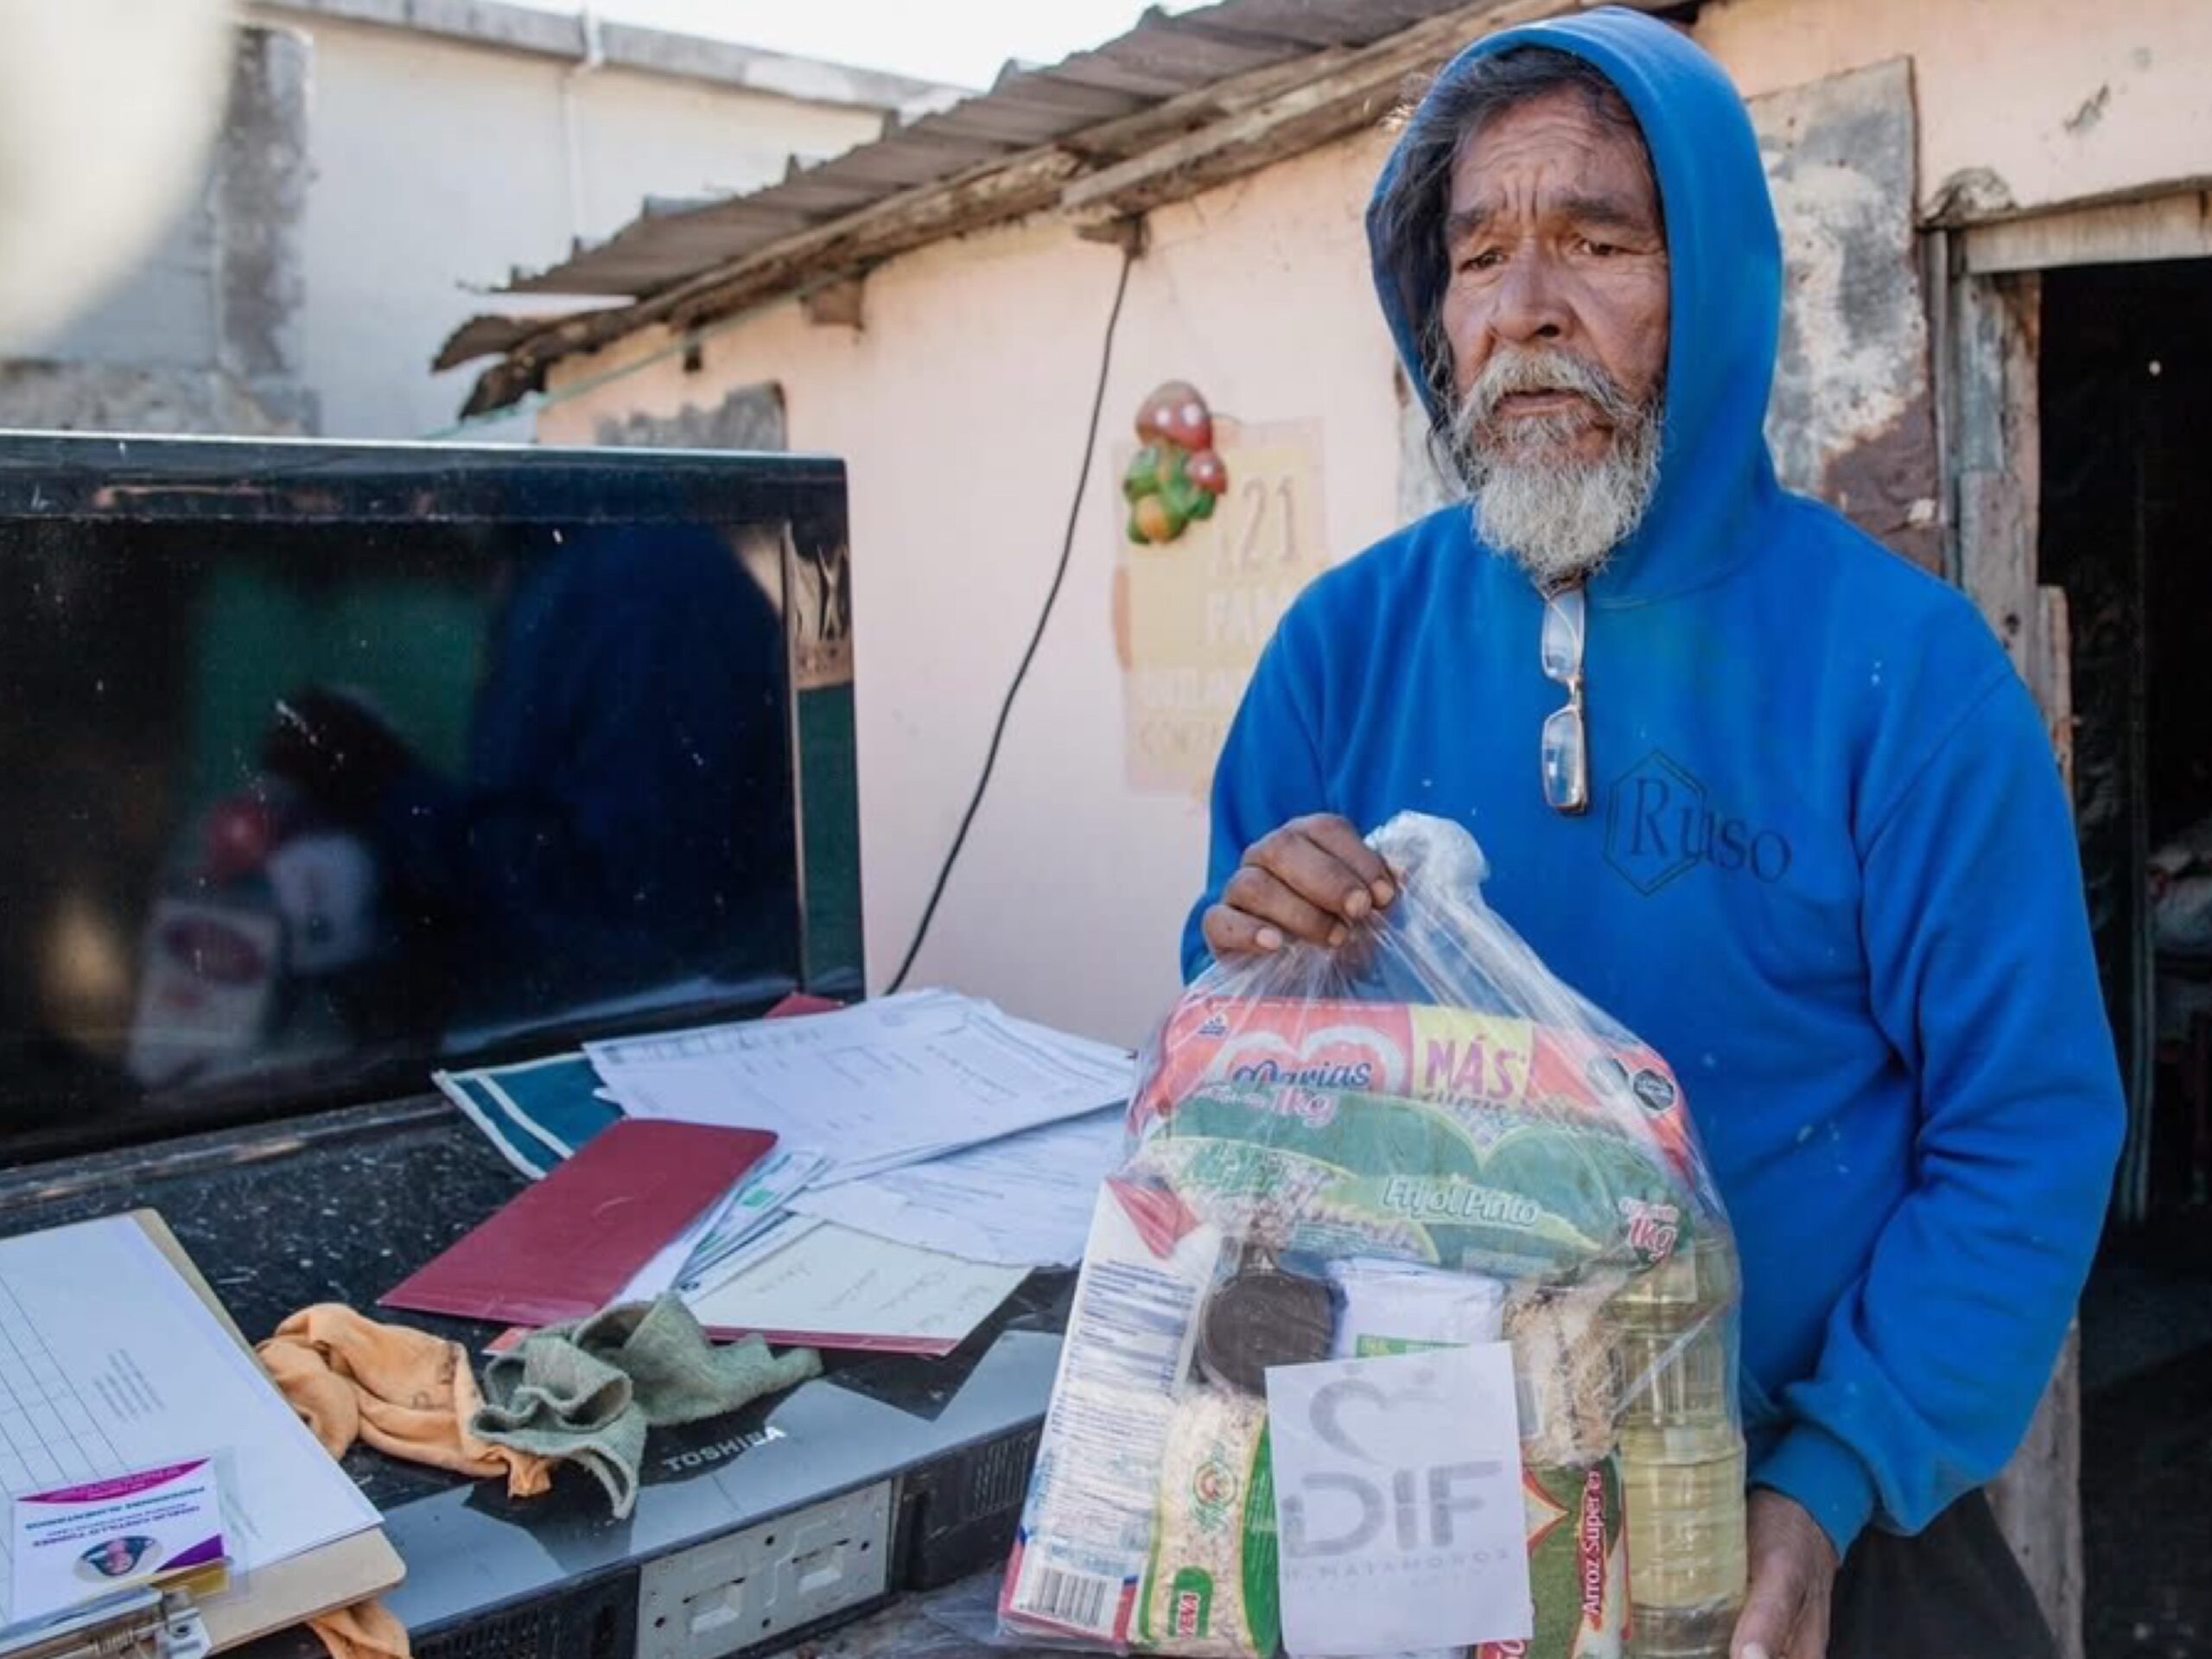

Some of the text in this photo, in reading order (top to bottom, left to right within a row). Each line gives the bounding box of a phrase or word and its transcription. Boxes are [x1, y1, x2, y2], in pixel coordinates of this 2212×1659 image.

[1630, 778, 1793, 884] Ruso
[1426, 1033, 1517, 1099] MÁS
[1463, 1185, 1542, 1226] Pinto
[662, 1426, 786, 1471] TOSHIBA
[1281, 1460, 1503, 1559] DIF
[1581, 1496, 1605, 1553] Super
[1581, 1558, 1600, 1614] Arroz
